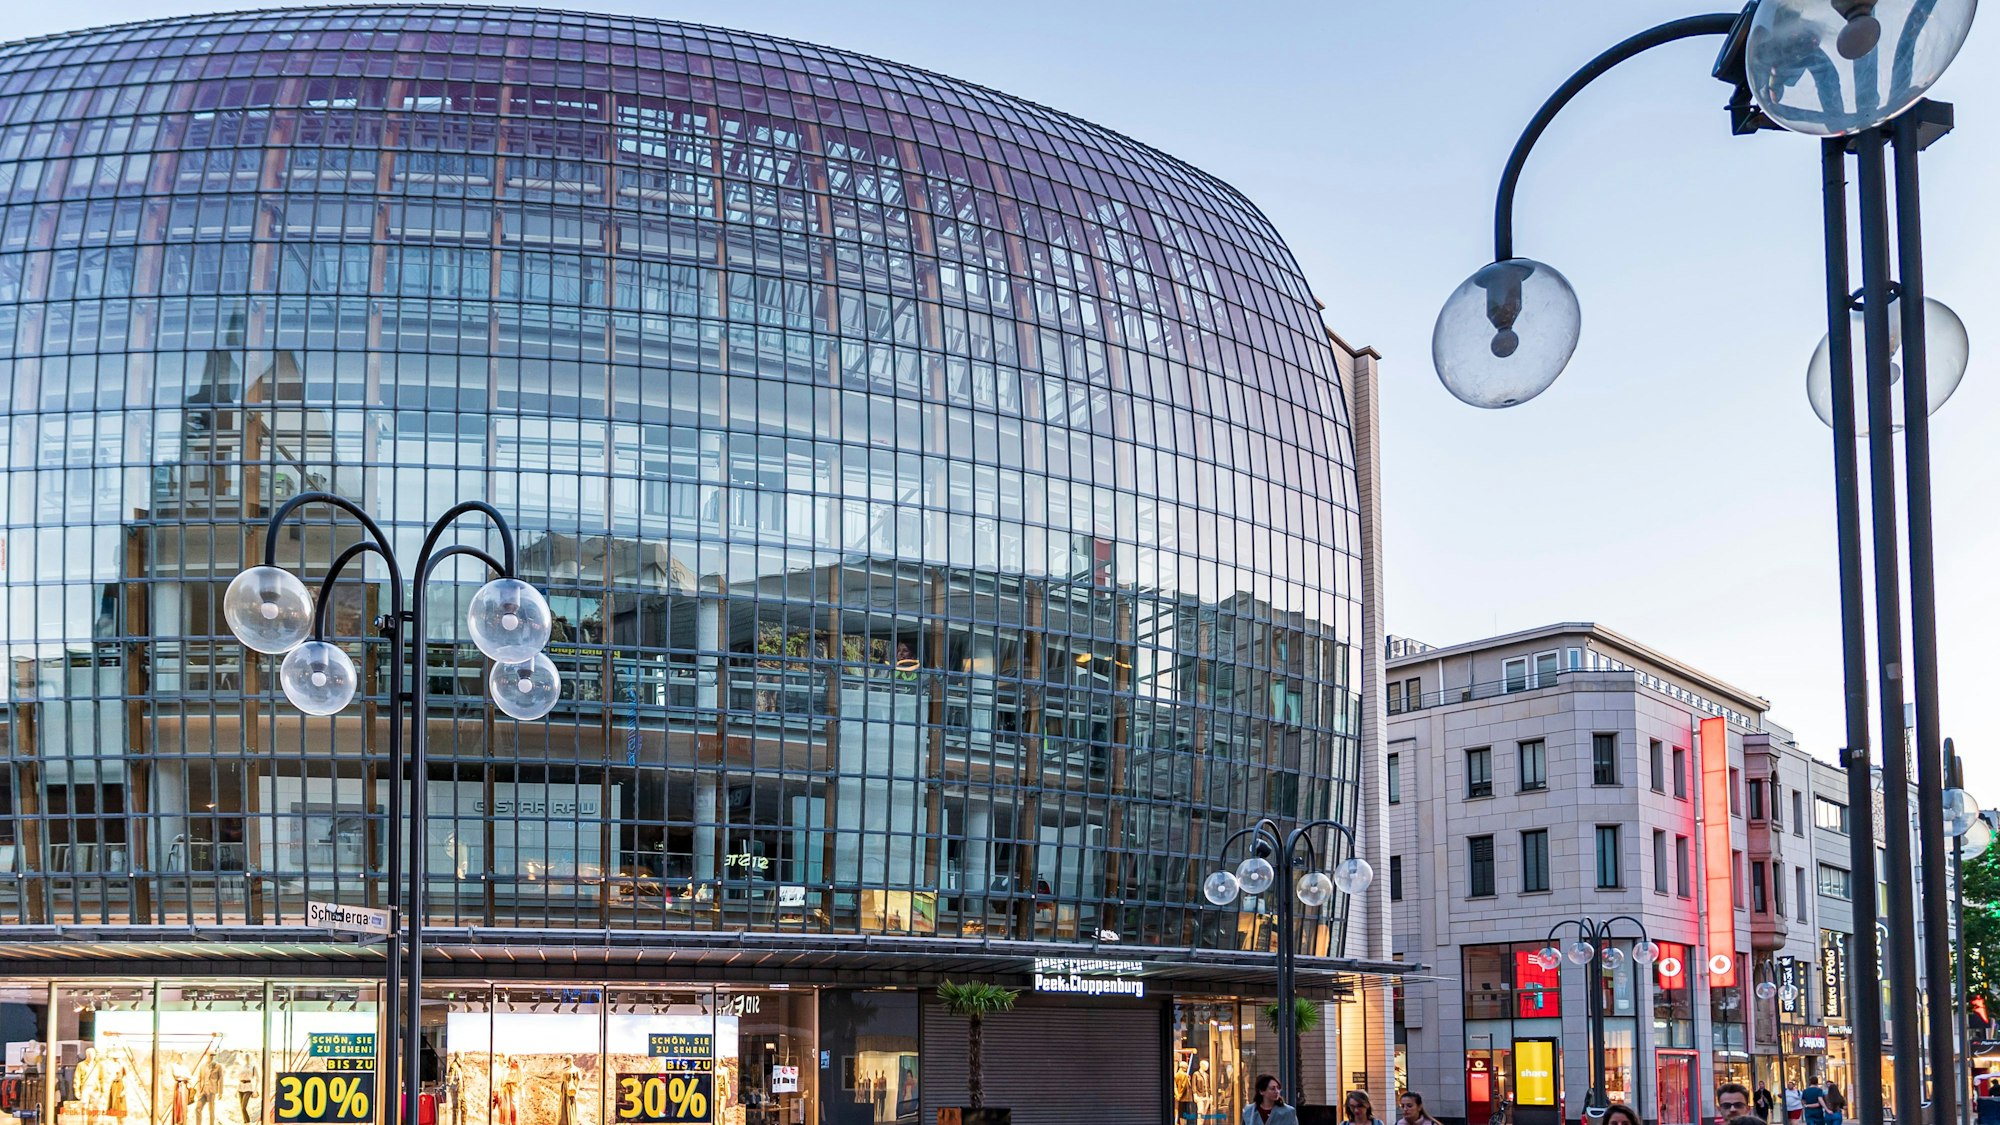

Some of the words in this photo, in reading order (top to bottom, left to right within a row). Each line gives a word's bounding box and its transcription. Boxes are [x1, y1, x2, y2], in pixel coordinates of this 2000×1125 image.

[312, 1035, 352, 1045] SCHÖN,
[356, 1036, 373, 1045] SIE
[651, 1036, 690, 1045] SCHÖN,
[694, 1037, 710, 1045] SIE
[656, 1046, 669, 1054] ZU
[327, 1060, 350, 1069] BIS
[356, 1060, 373, 1069] ZU
[667, 1061, 688, 1070] BIS
[695, 1061, 711, 1070] ZU
[1521, 1069, 1548, 1078] share
[279, 1076, 369, 1119] 30%
[620, 1077, 707, 1119] 30%
